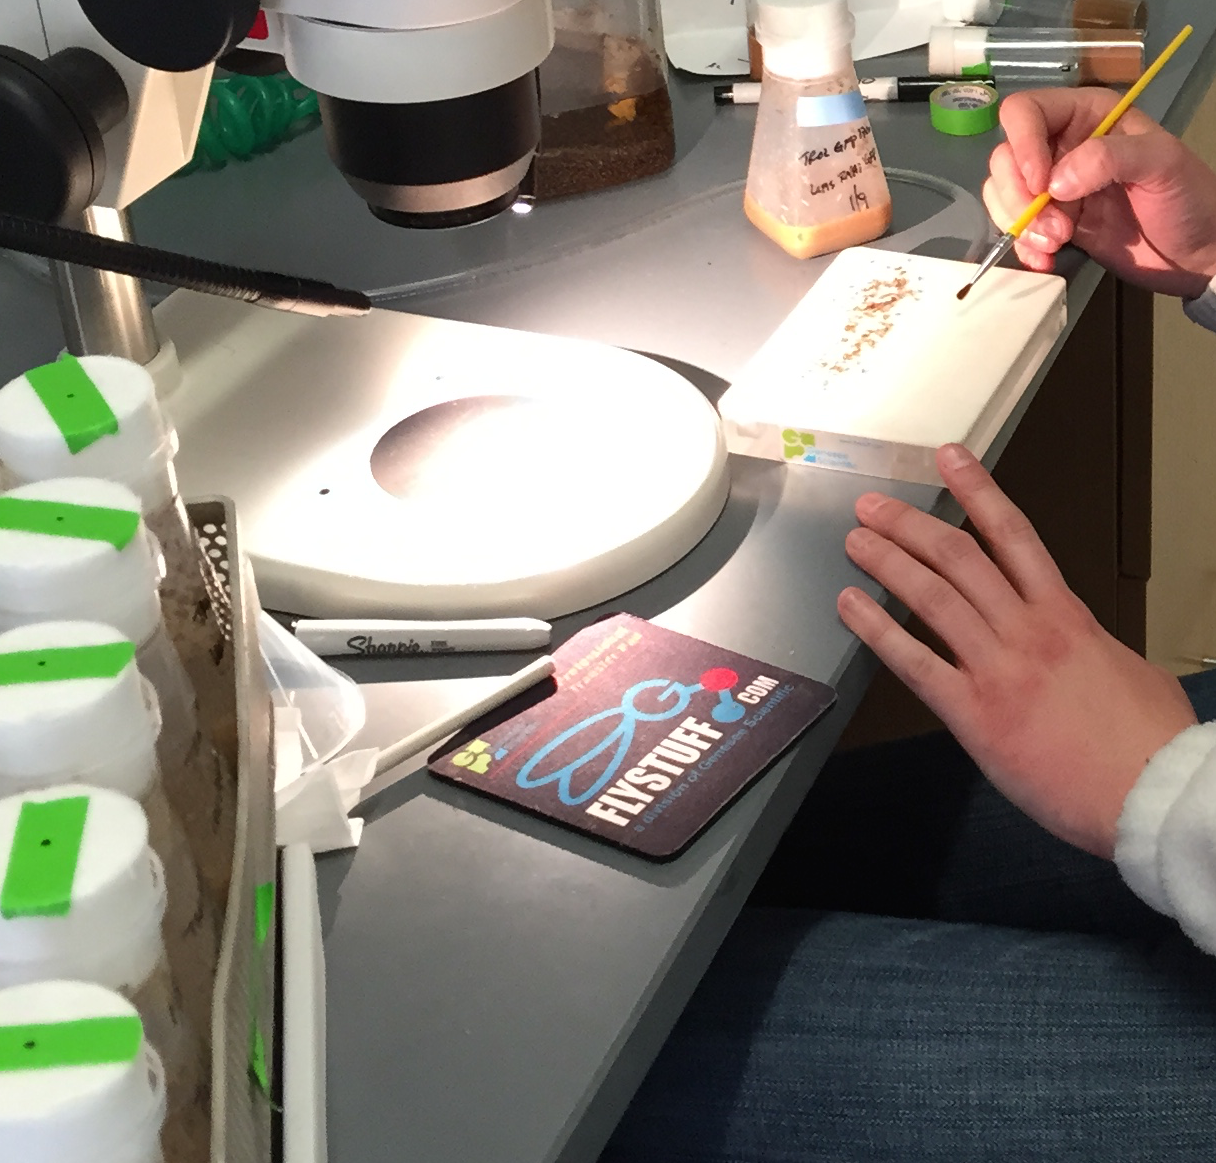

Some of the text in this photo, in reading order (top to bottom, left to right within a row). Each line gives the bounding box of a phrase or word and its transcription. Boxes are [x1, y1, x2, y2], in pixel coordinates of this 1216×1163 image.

[346, 635, 421, 655] Sharpie
[737, 674, 780, 705] COM
[585, 715, 724, 827] FLYSTUFF
[642, 782, 689, 823] division
[698, 727, 748, 771] Genesee
[743, 684, 795, 728] Scientific
